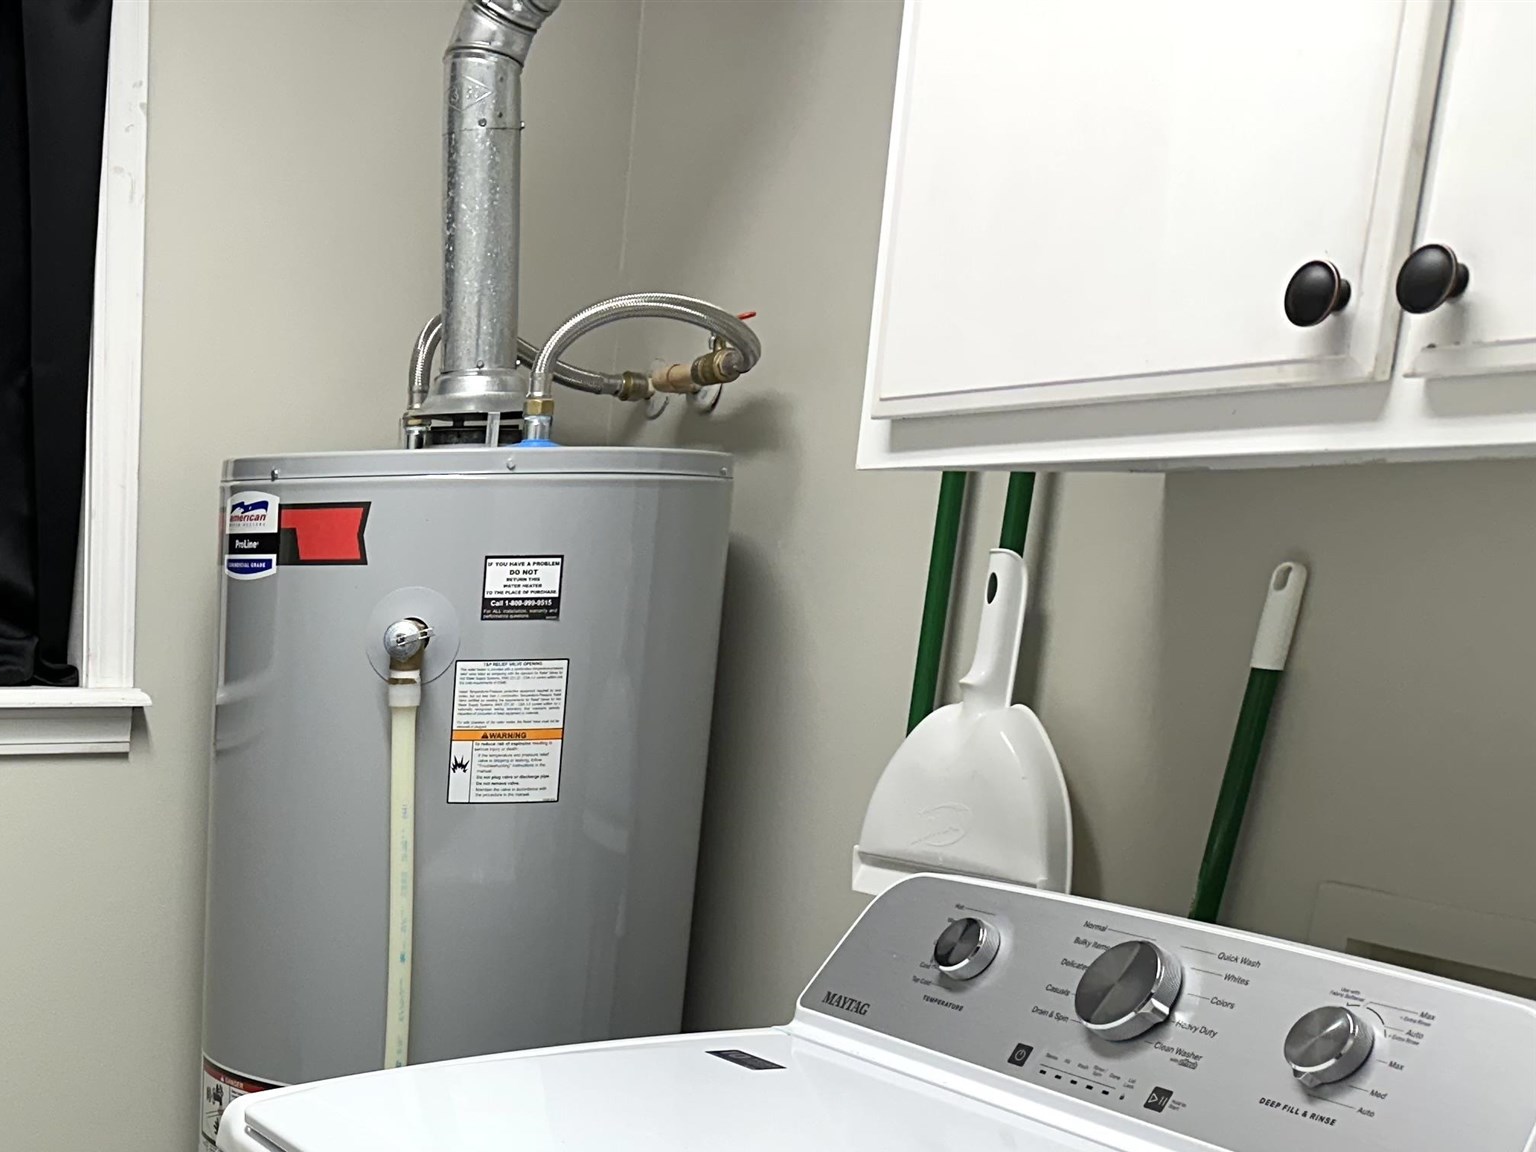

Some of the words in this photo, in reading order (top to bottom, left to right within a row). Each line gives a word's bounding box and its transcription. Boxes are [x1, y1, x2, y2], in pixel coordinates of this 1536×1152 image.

[230, 514, 267, 523] american
[235, 539, 257, 549] ProLine
[1083, 920, 1108, 932] Normal
[1073, 936, 1092, 949] Bulky
[1060, 958, 1088, 971] Delicate
[1217, 952, 1239, 964] Quick
[1239, 956, 1261, 969] Wash
[1224, 972, 1249, 986] Whites
[1045, 983, 1071, 997] Casuals
[822, 991, 871, 1016] MAYTAG
[923, 994, 964, 1012] TEMPERATURE
[1210, 996, 1235, 1009] Colors
[1031, 1005, 1048, 1018] Drain
[1054, 1011, 1069, 1024] Spin
[1419, 1011, 1436, 1021] Max
[1199, 1025, 1218, 1039] Duty
[1405, 1029, 1424, 1039] Auto
[1154, 1041, 1175, 1054] Clean
[1175, 1047, 1203, 1061] Washer
[1388, 1060, 1405, 1072] Max
[1369, 1088, 1388, 1101] Med
[1258, 1096, 1282, 1110] DEEP
[1281, 1103, 1301, 1118] FILL
[1300, 1110, 1309, 1118] &
[1309, 1112, 1338, 1128] RINSE
[1356, 1106, 1376, 1119] Auto
